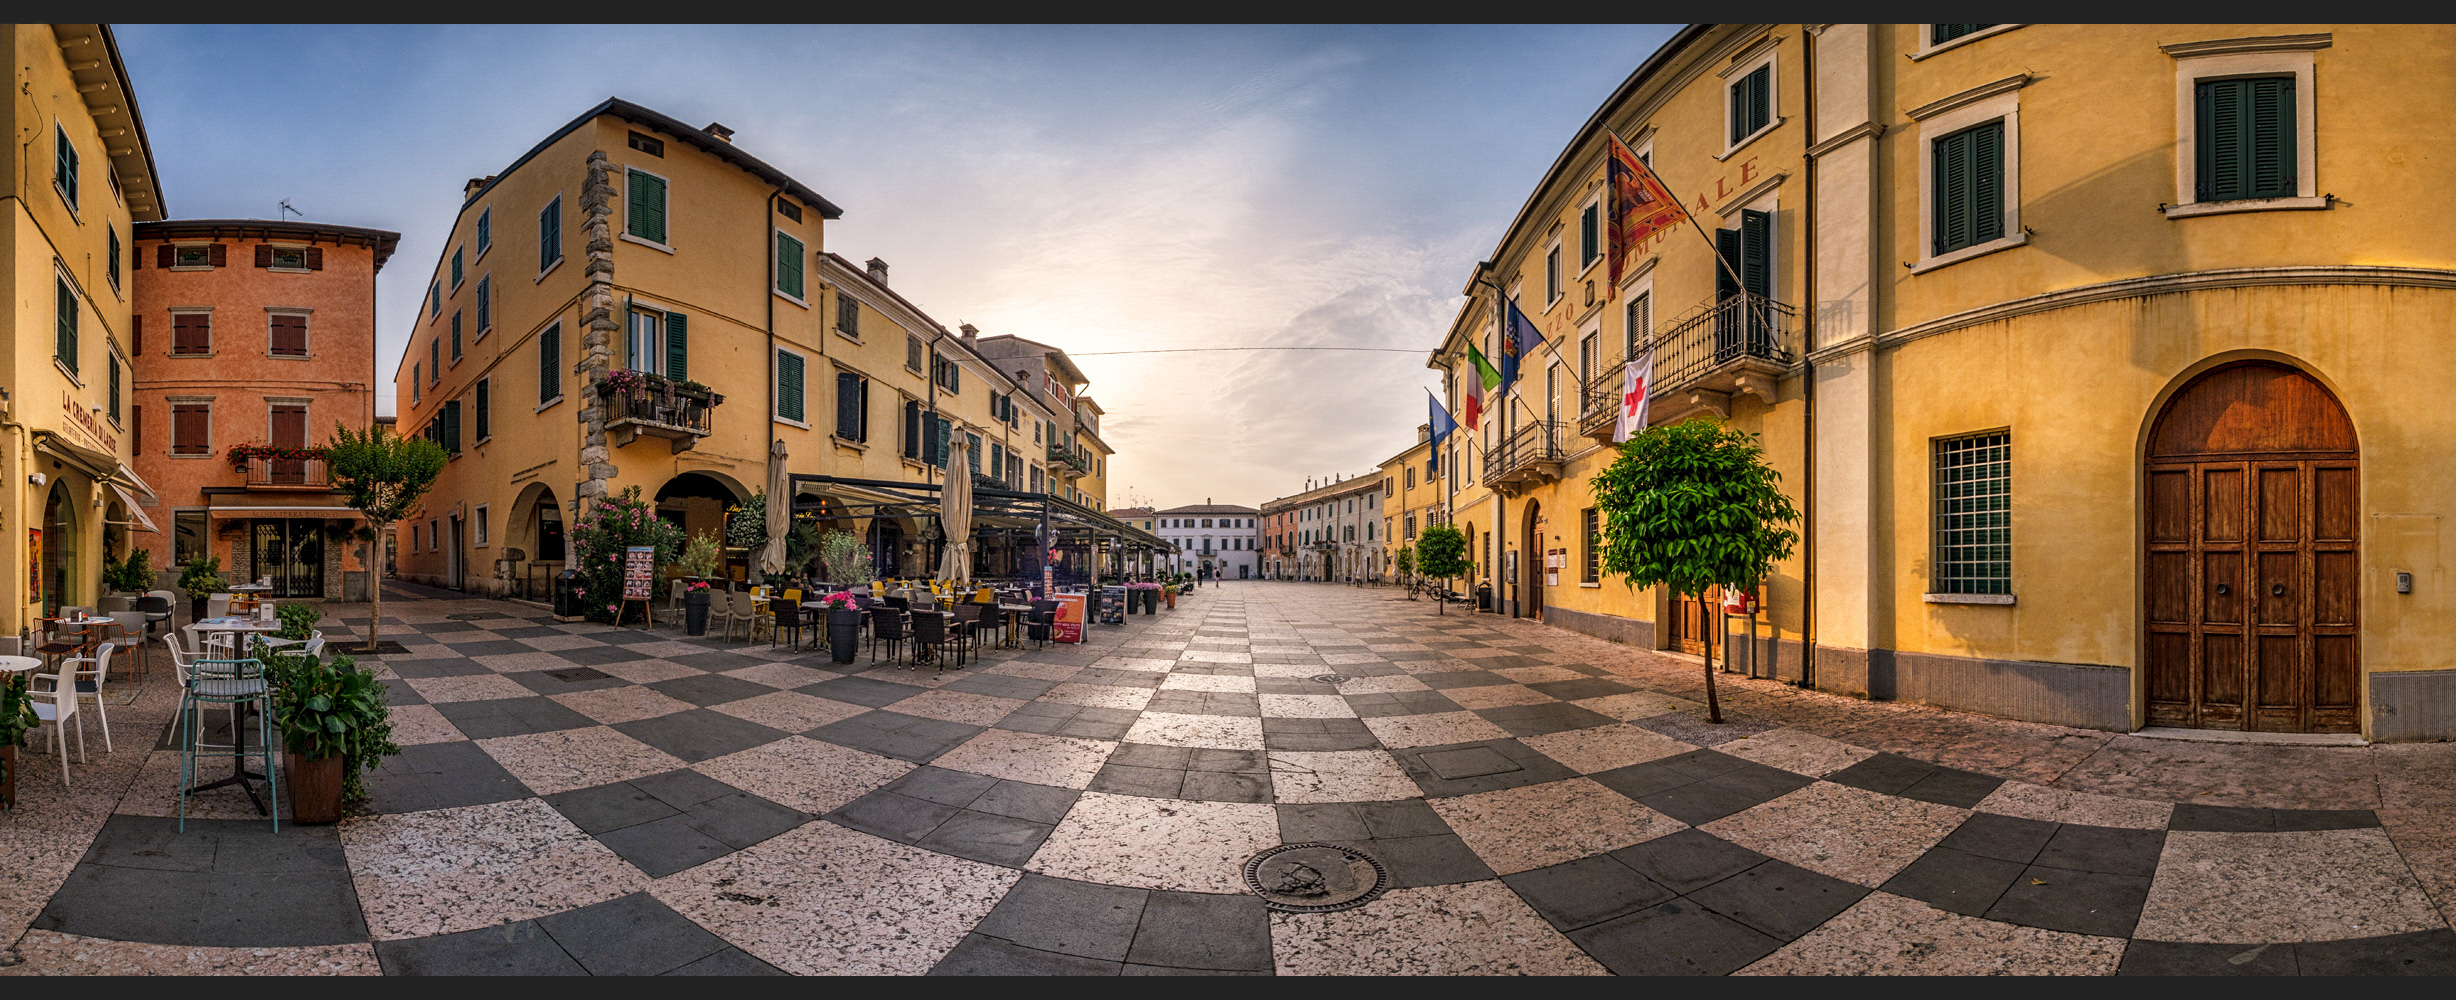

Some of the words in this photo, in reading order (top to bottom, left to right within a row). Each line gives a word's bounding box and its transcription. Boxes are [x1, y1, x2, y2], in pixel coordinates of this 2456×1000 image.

[63, 390, 71, 414] LA
[73, 401, 97, 437] CREMERIA
[98, 424, 103, 442] DI
